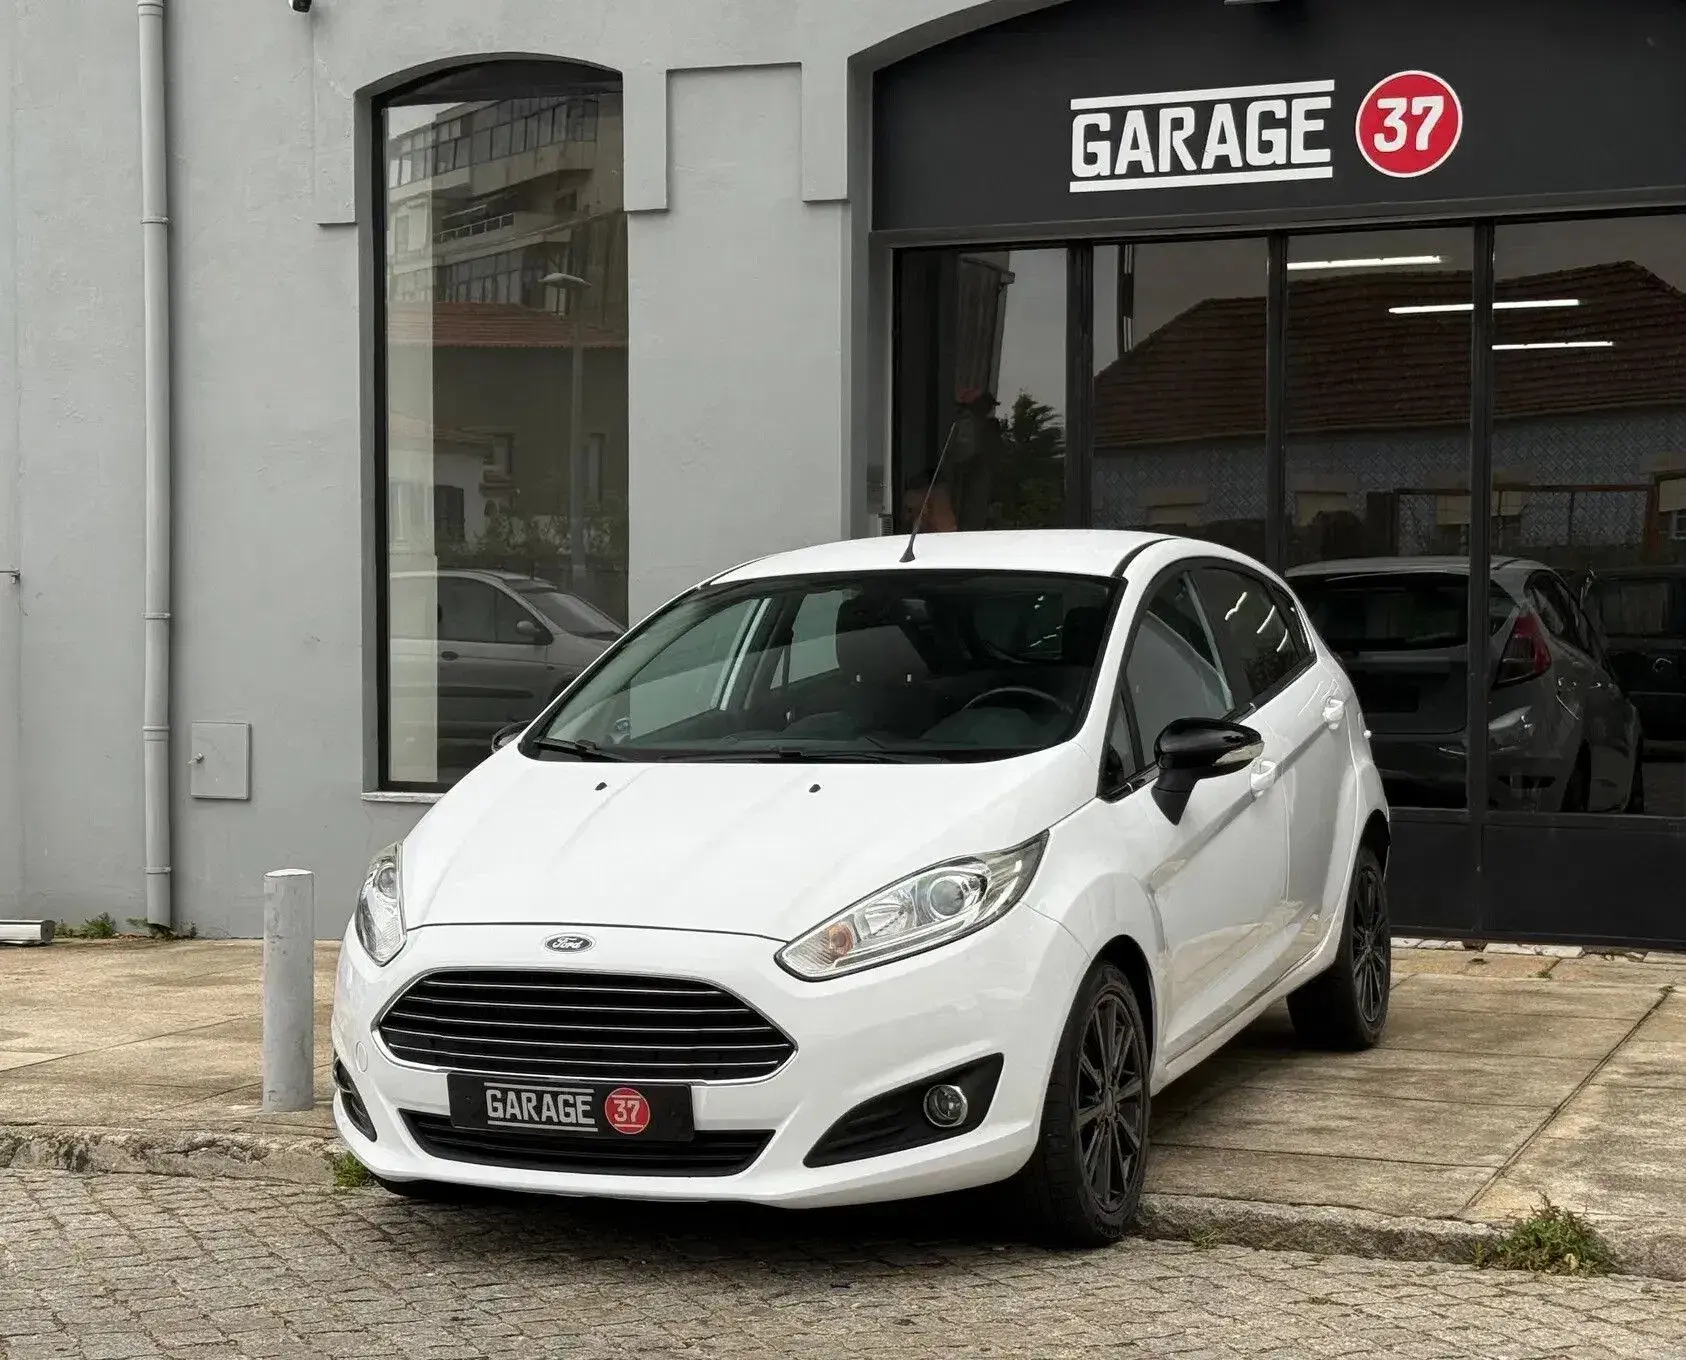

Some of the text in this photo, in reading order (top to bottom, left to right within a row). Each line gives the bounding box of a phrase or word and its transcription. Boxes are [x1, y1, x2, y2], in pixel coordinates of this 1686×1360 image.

[1072, 95, 1445, 178] GARAGE 37
[552, 937, 584, 949] Ford
[485, 1088, 640, 1125] GARAGE 37
